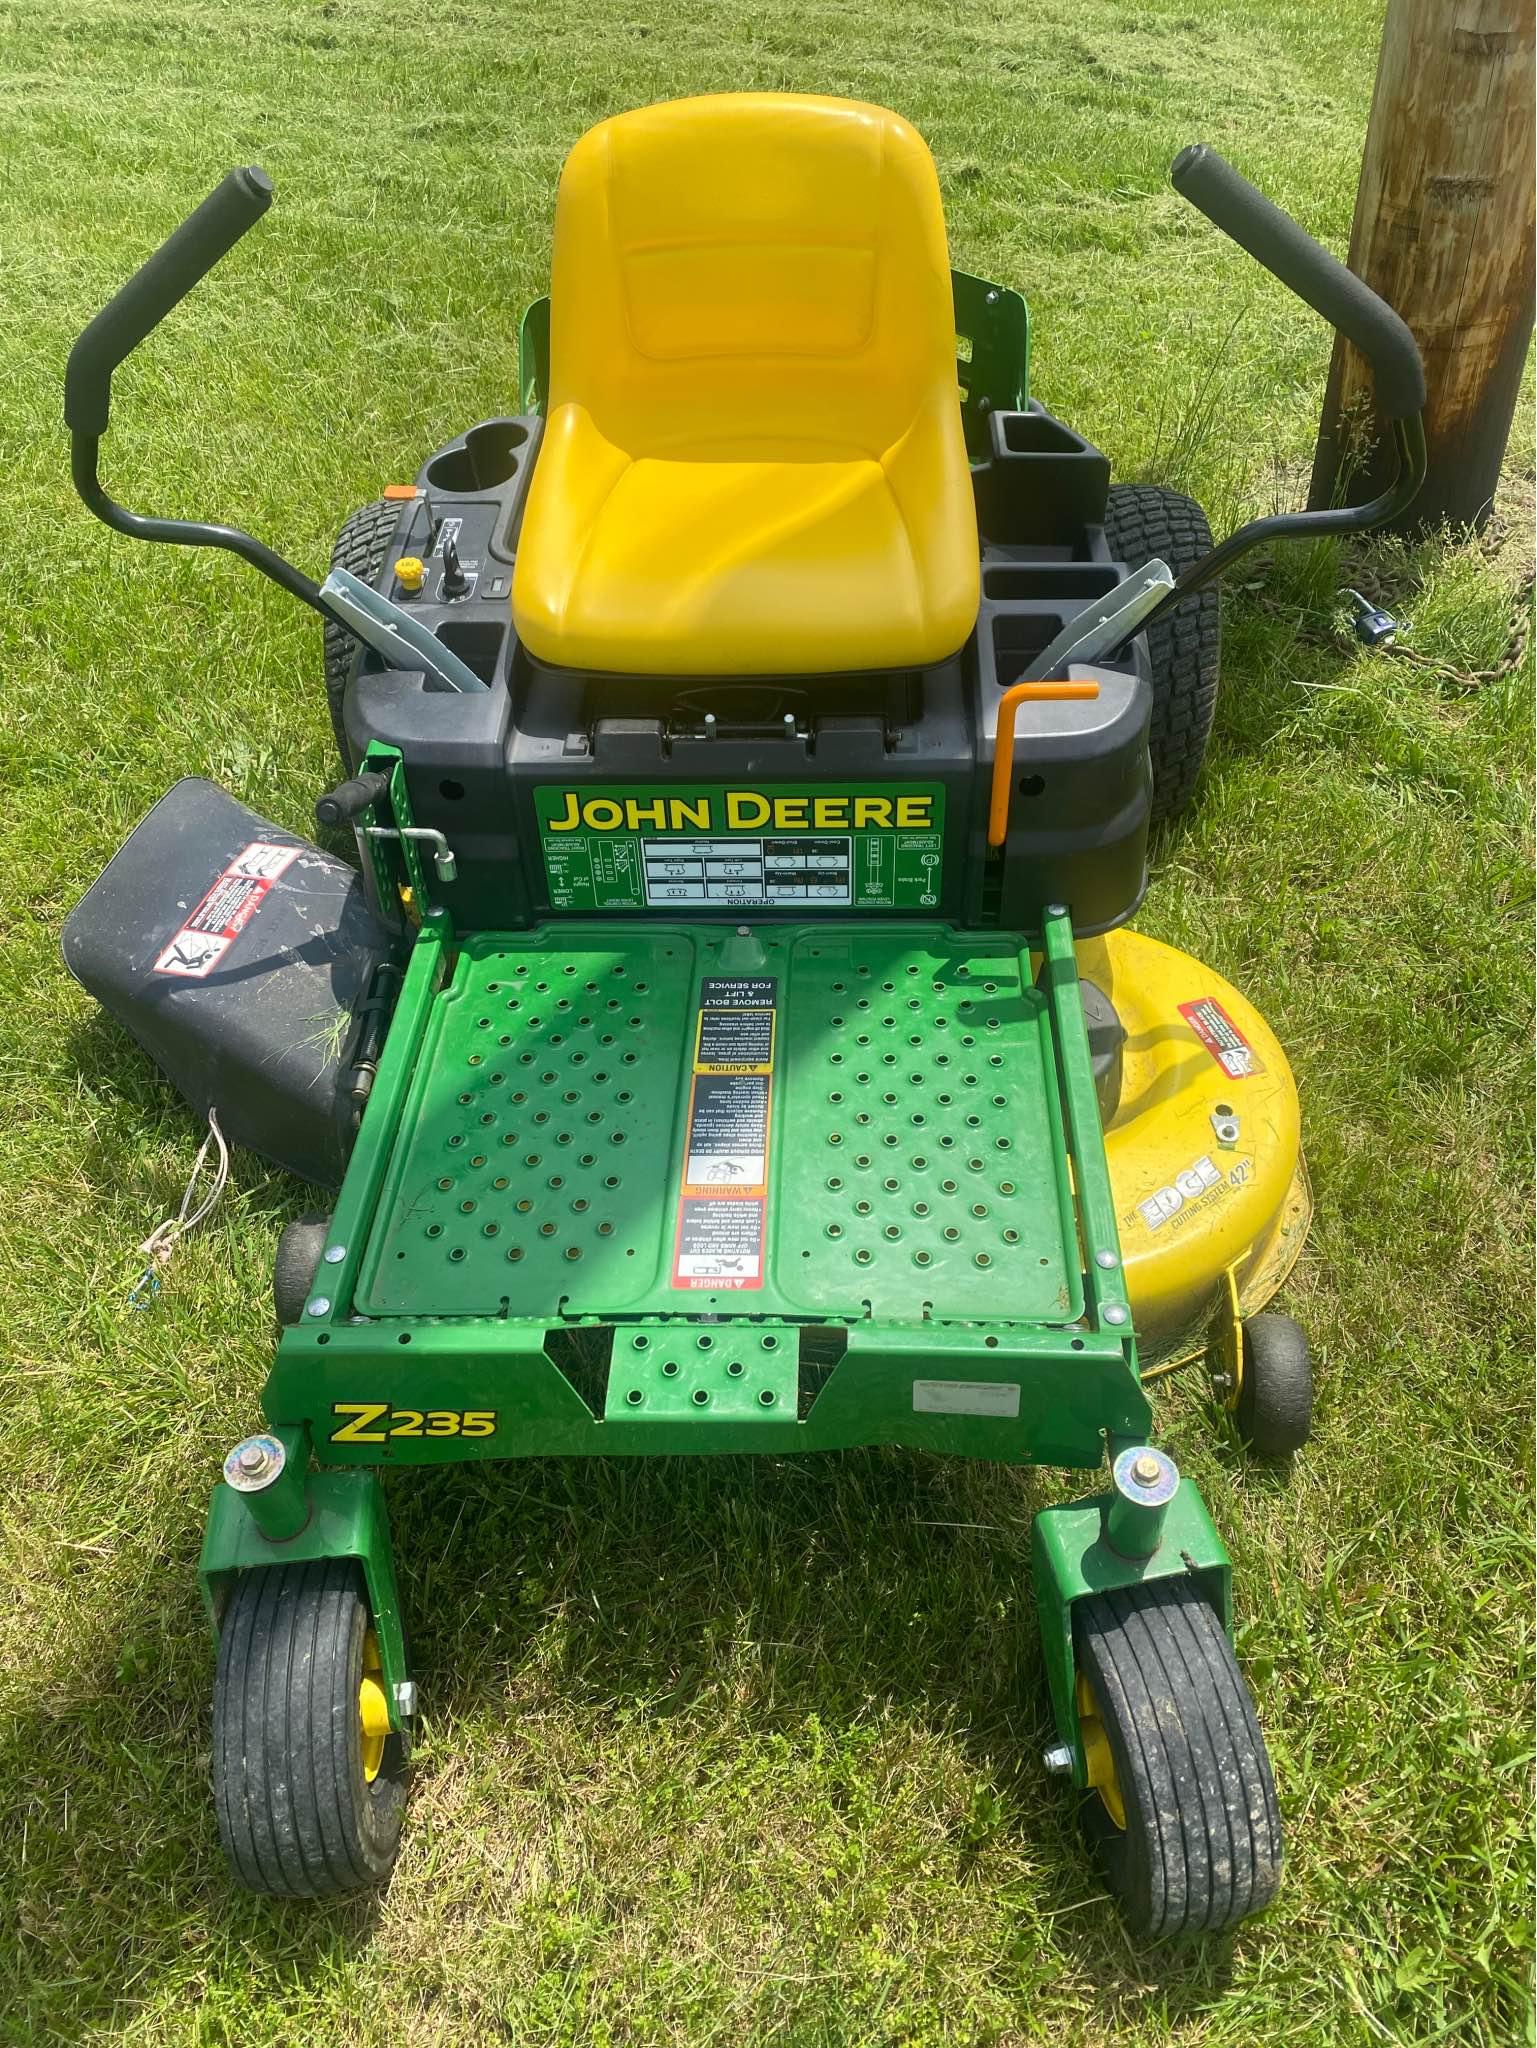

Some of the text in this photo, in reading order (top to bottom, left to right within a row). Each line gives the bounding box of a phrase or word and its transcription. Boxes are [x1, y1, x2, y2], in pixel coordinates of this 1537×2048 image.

[549, 792, 932, 831] JOHN DEERE
[1136, 1156, 1222, 1232] EDGE
[1171, 1159, 1250, 1229] CUTTING SYSTEM 42"
[1124, 1211, 1137, 1227] THE
[690, 1279, 732, 1288] DANGER
[331, 1405, 496, 1442] Z235
